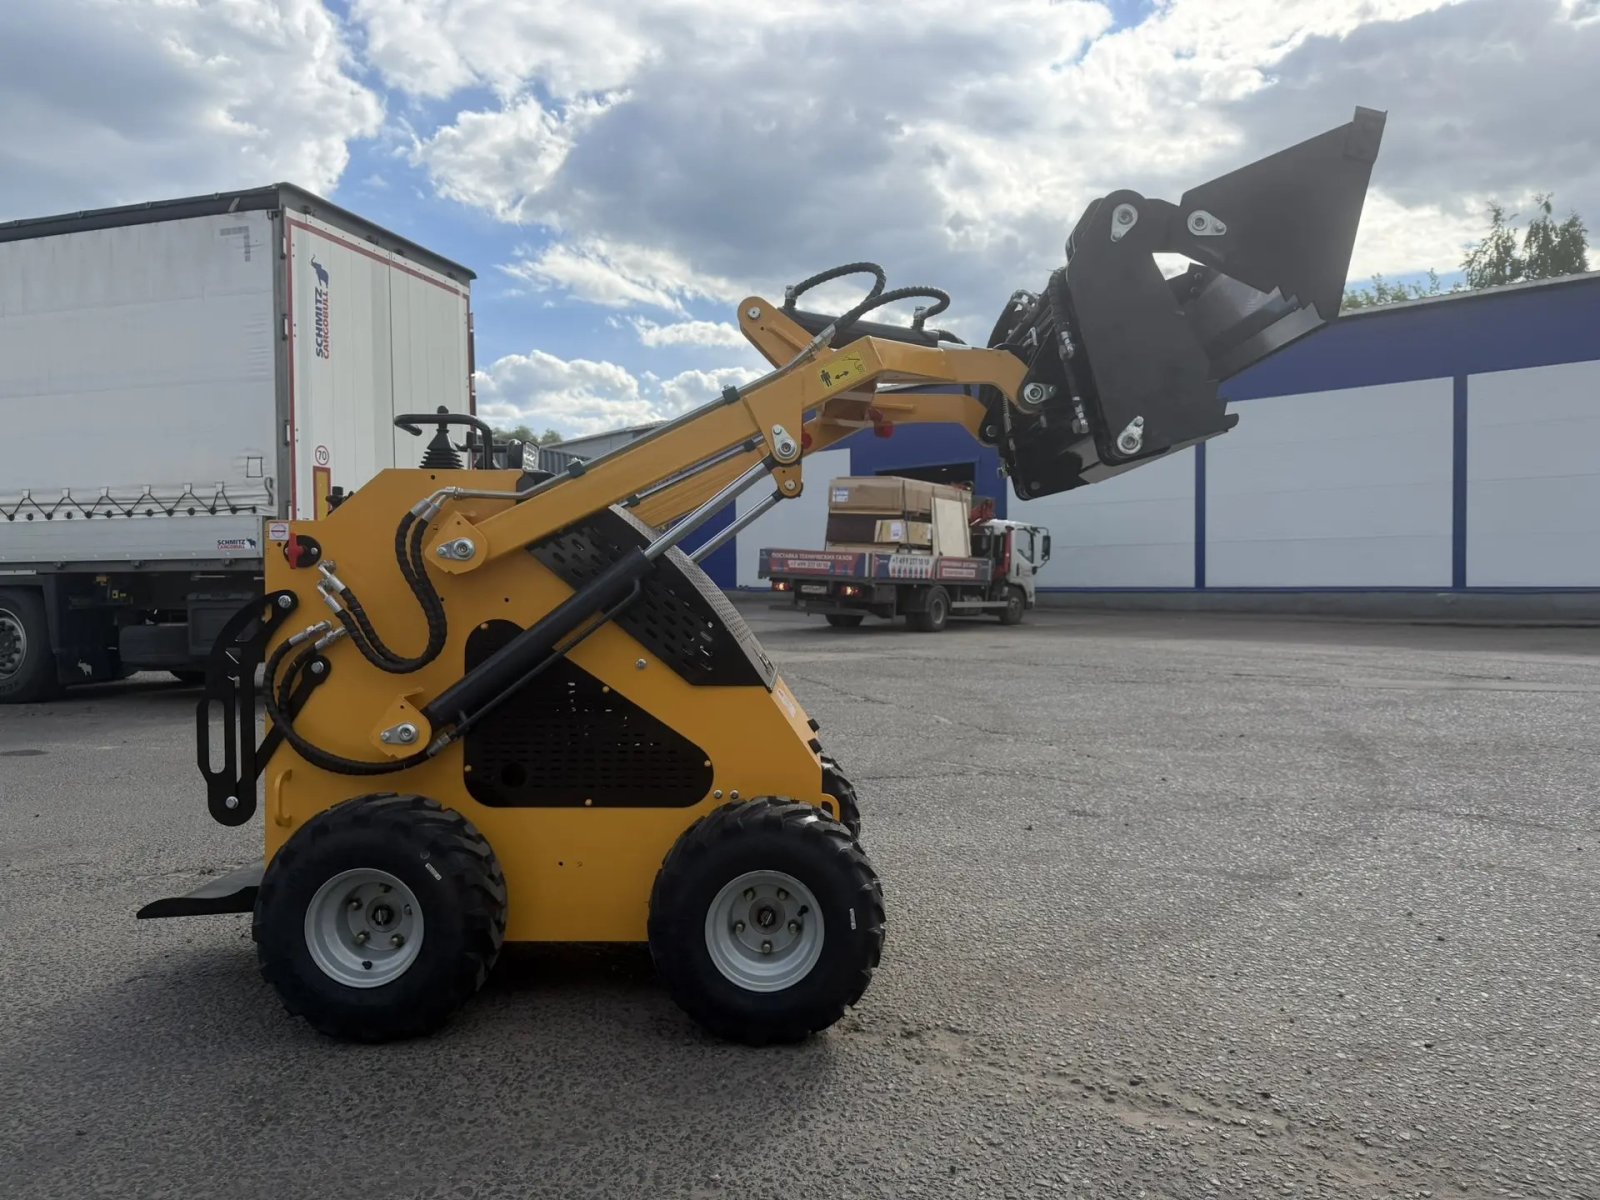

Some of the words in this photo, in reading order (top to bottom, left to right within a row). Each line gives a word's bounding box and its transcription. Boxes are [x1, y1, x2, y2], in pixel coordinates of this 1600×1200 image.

[315, 286, 323, 358] SCHMITZ
[322, 290, 330, 359] CARGOBULL
[318, 450, 327, 461] 70
